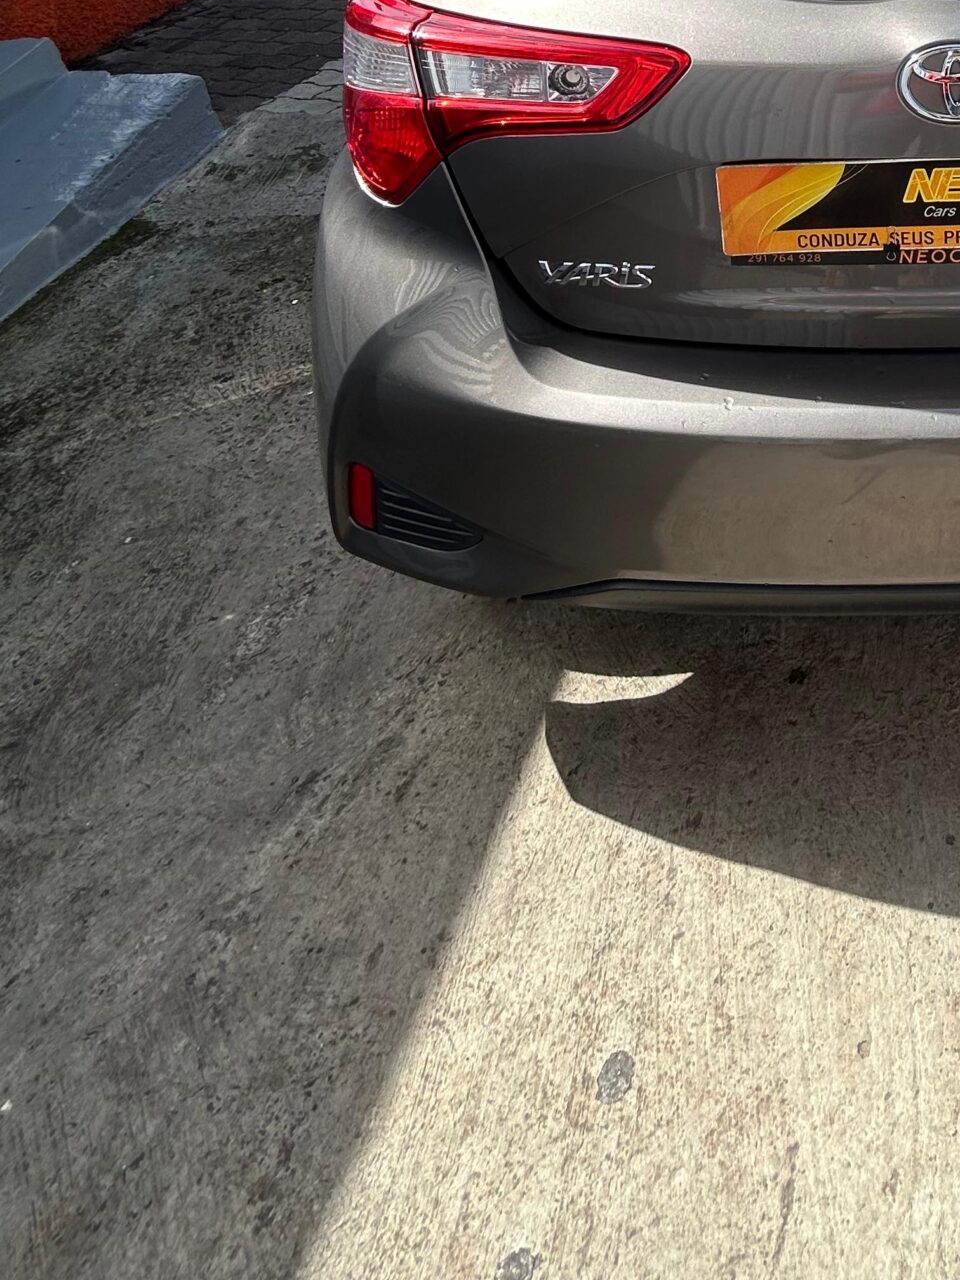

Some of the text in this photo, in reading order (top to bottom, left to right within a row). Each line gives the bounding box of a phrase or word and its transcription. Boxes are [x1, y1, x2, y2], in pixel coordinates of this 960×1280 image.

[924, 206, 957, 217] Cars
[797, 232, 880, 248] CONDUZA
[889, 230, 935, 246] SEUS
[747, 252, 822, 263] 291 764 928
